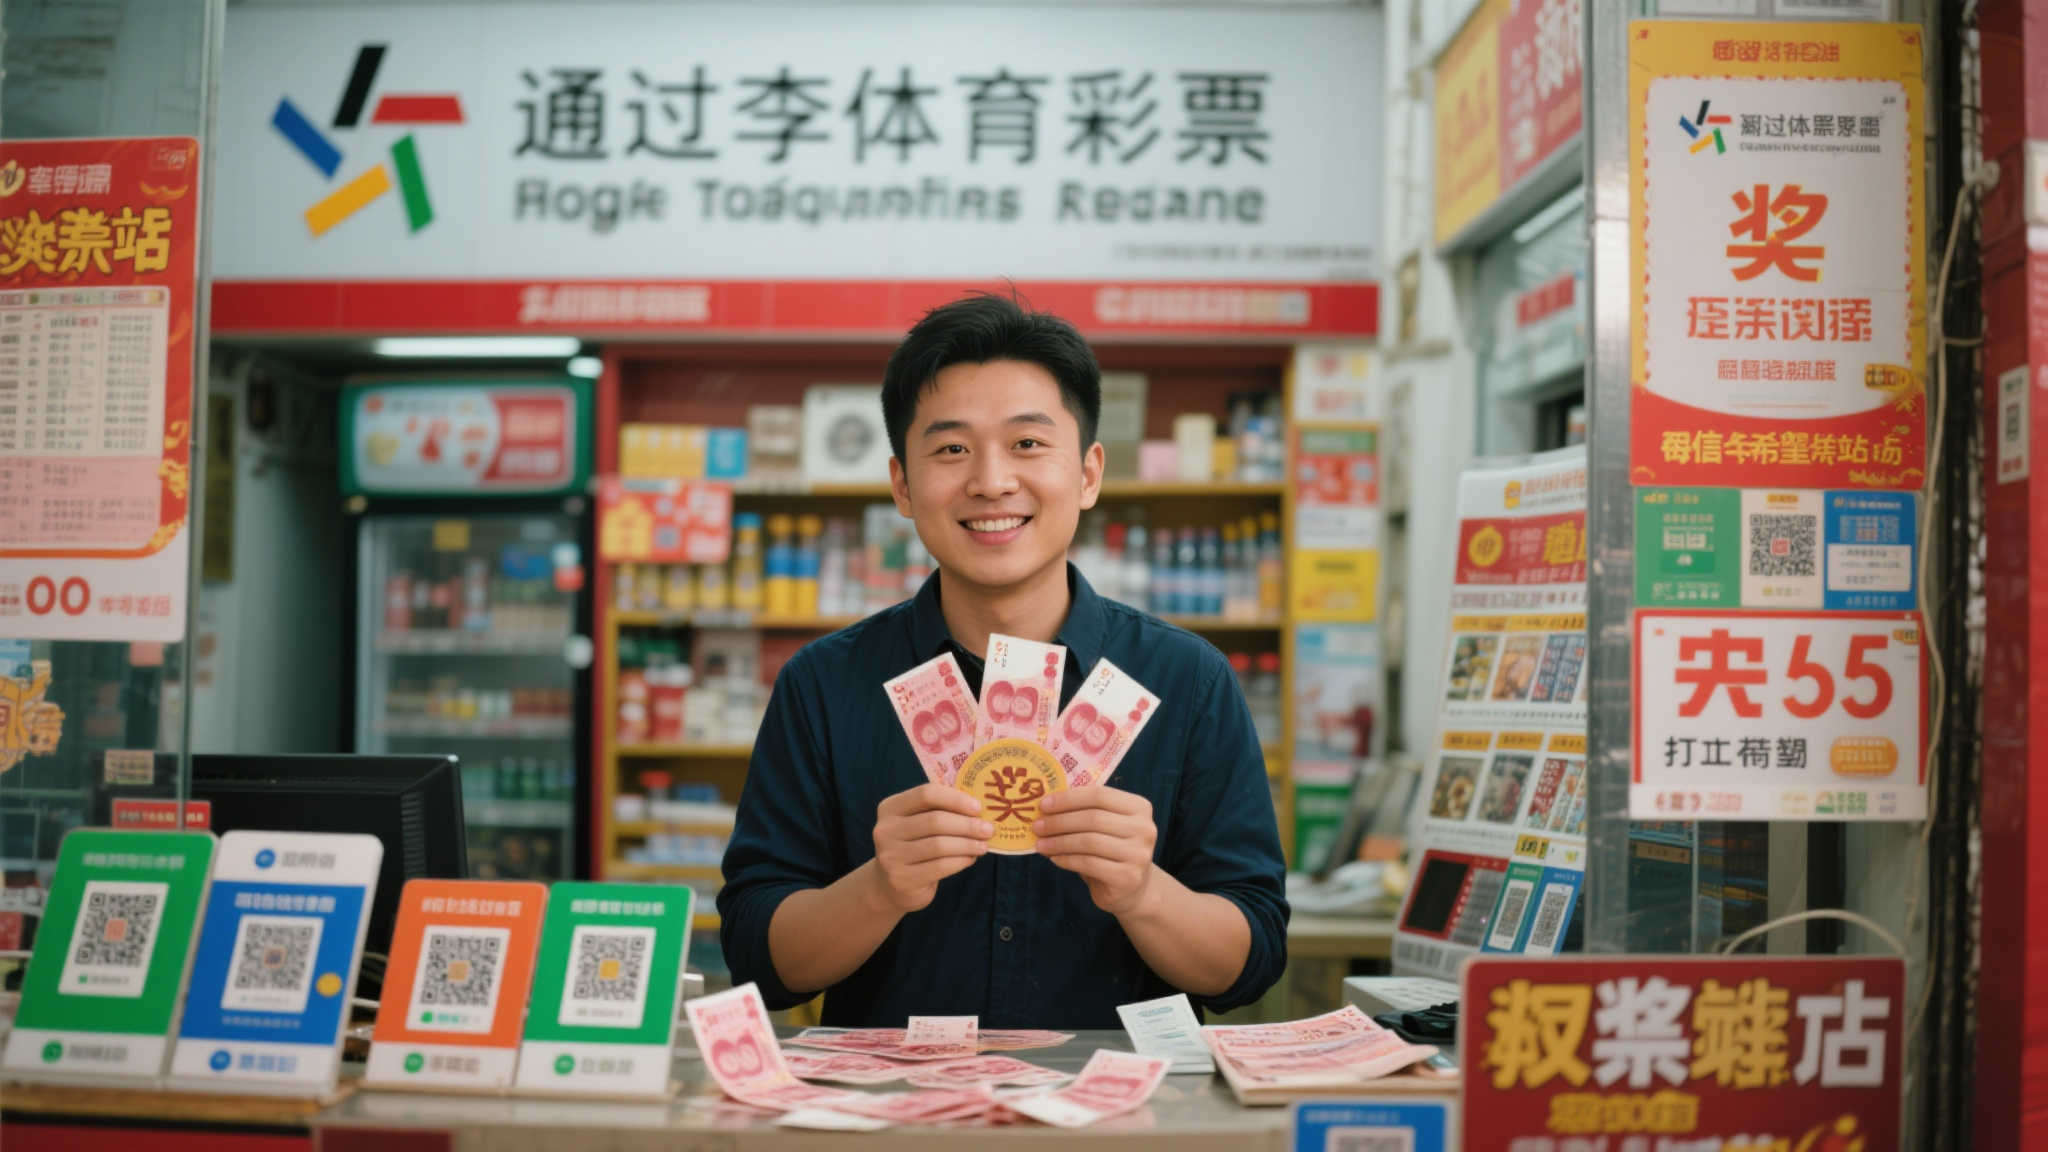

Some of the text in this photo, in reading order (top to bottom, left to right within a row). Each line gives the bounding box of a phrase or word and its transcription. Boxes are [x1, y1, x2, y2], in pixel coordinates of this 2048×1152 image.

[514, 64, 1271, 166] 通过李体育彩票
[1726, 183, 1829, 283] 奖
